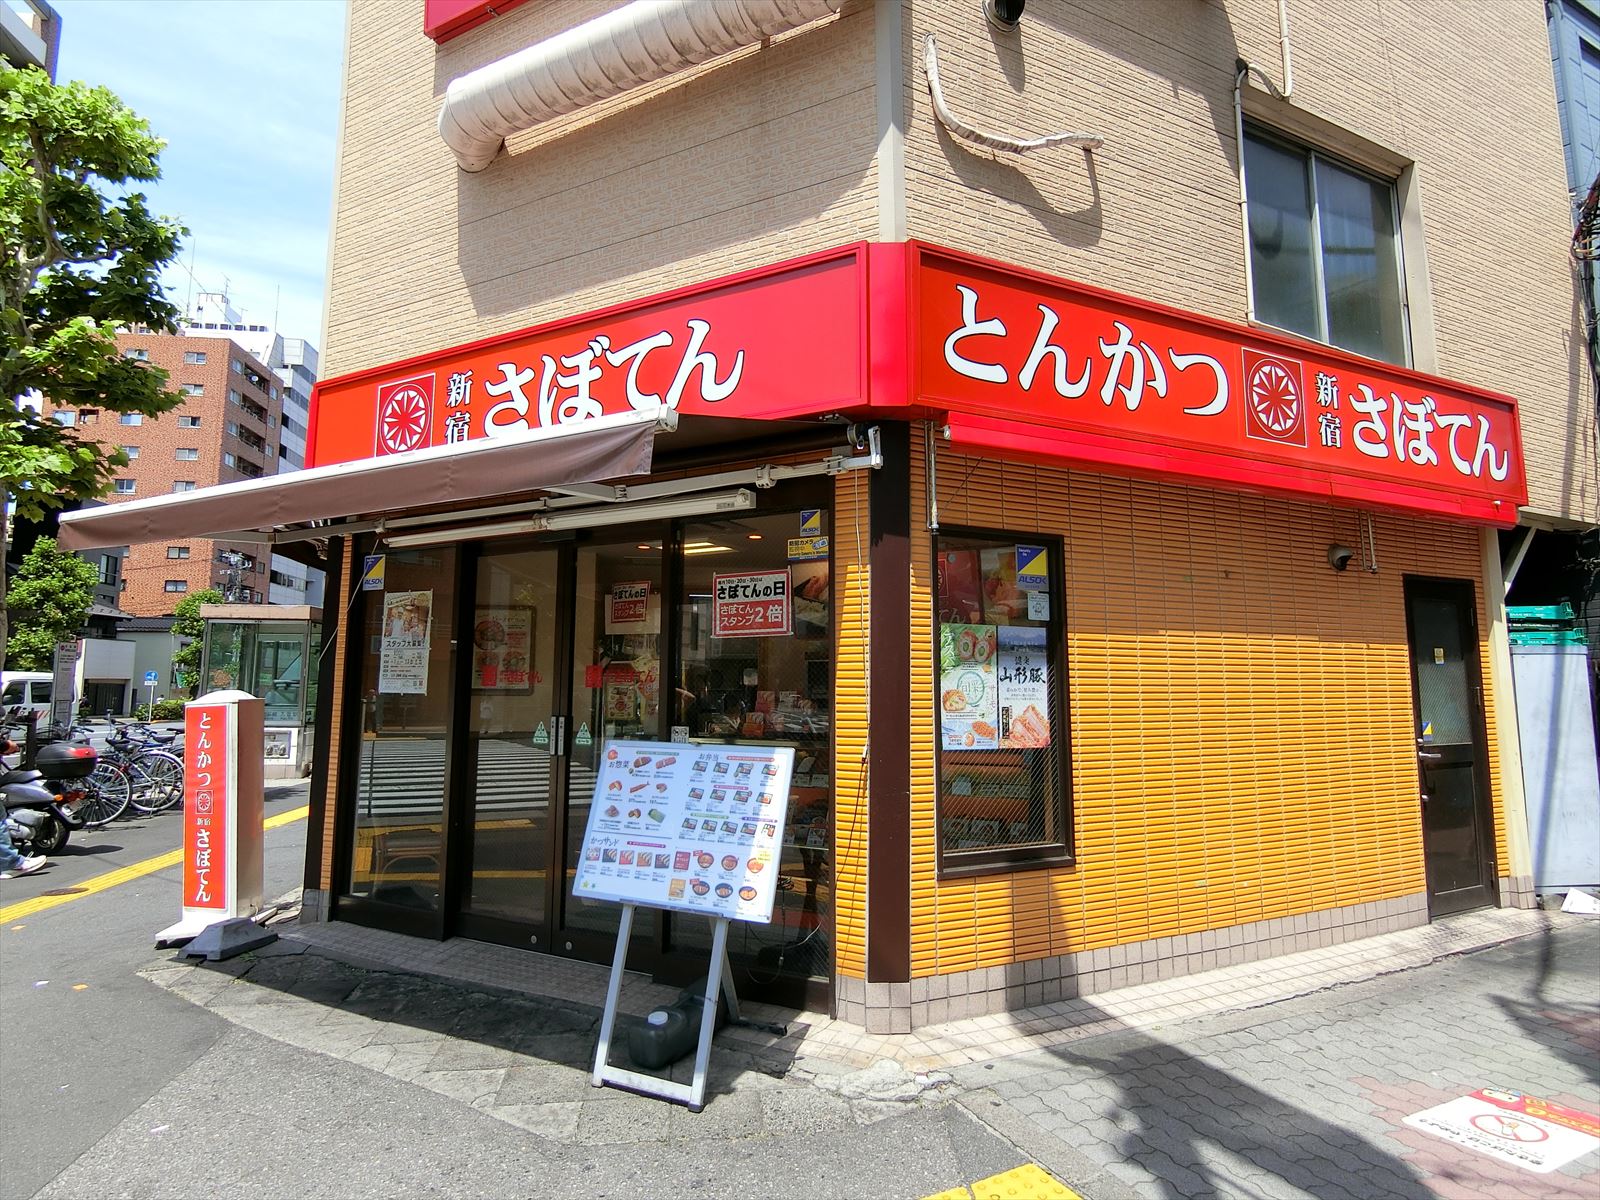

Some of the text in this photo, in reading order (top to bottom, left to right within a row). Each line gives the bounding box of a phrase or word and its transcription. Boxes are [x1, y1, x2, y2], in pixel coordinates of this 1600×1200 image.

[943, 283, 1230, 416] とんかつ
[484, 319, 746, 438] さぼてん
[445, 369, 474, 444] 新宿
[1315, 371, 1343, 449] 新宿
[1349, 383, 1511, 481] さぼてん
[613, 588, 647, 600] さぼてんの日
[717, 580, 786, 600] さぼてんの日
[1018, 576, 1047, 585] ALSOK
[720, 604, 754, 615] さぼてん
[720, 615, 755, 627] スタンプ
[754, 604, 783, 623] 2倍
[999, 667, 1047, 685] 山形豚
[196, 712, 212, 788] とんかつ
[195, 829, 212, 902] さぼてん
